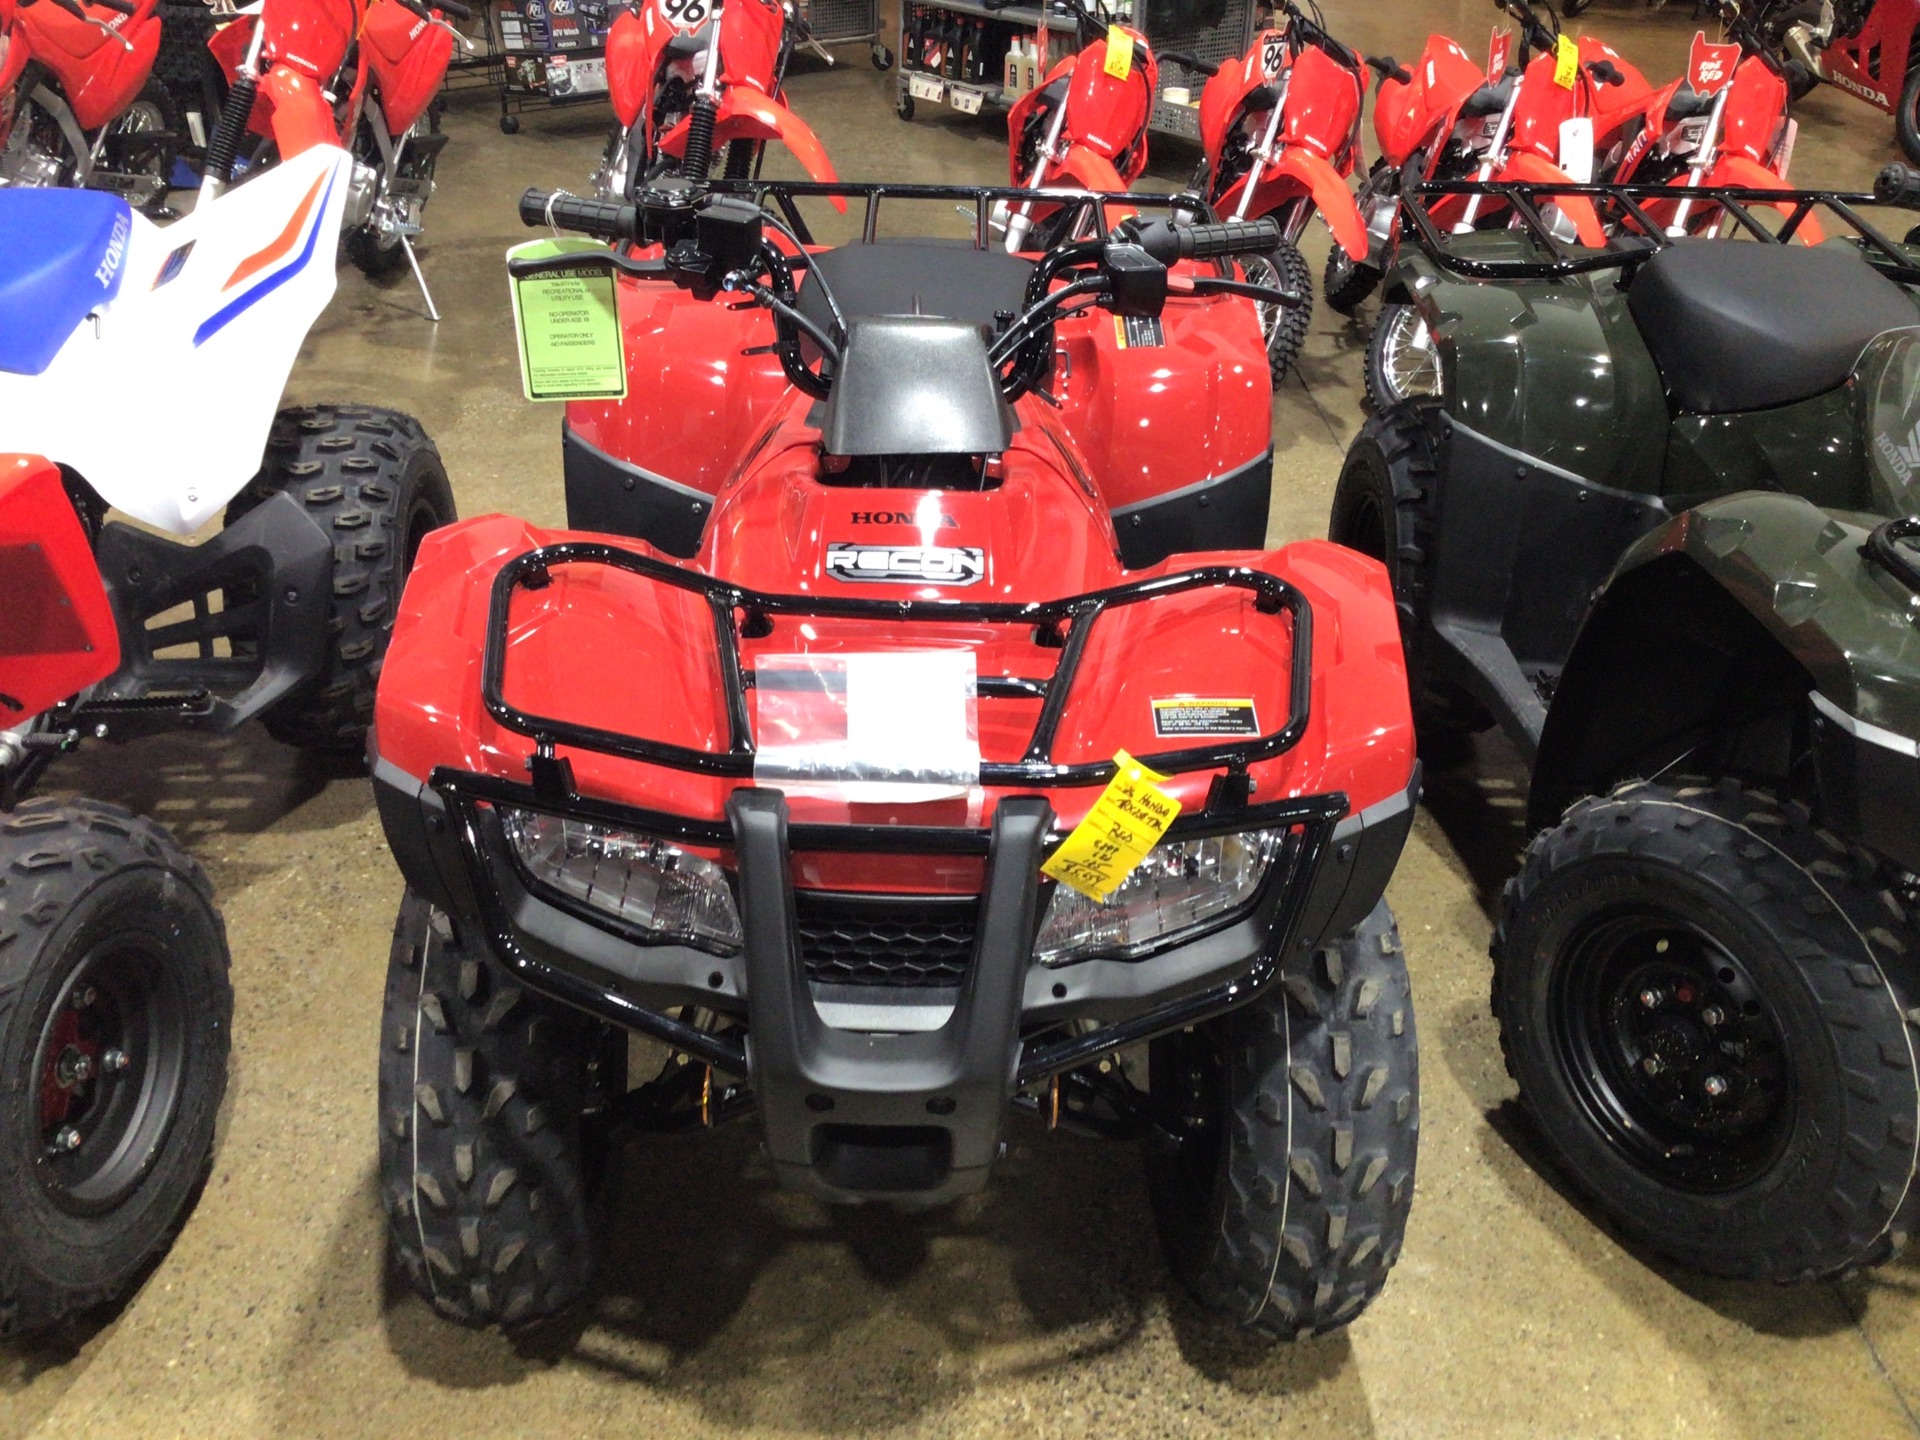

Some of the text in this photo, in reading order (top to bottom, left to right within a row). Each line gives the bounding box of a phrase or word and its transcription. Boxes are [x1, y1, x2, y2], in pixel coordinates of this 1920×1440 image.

[664, 0, 705, 23] 96
[552, 28, 580, 37] ATV Winch
[286, 52, 319, 72] HONDA
[1264, 45, 1283, 73] 96
[1699, 60, 1722, 70] RIDE
[1698, 71, 1723, 84] RED
[1832, 69, 1890, 107] HONDA
[1086, 132, 1113, 151] HONDA
[94, 211, 130, 290] HONDA
[562, 269, 577, 279] USE
[577, 267, 605, 277] MODEL
[560, 339, 596, 347] PASSENGERS
[1875, 432, 1913, 487] HONDA
[850, 511, 960, 529] HONA
[825, 549, 985, 574] RECON
[1138, 792, 1171, 817] HONDA
